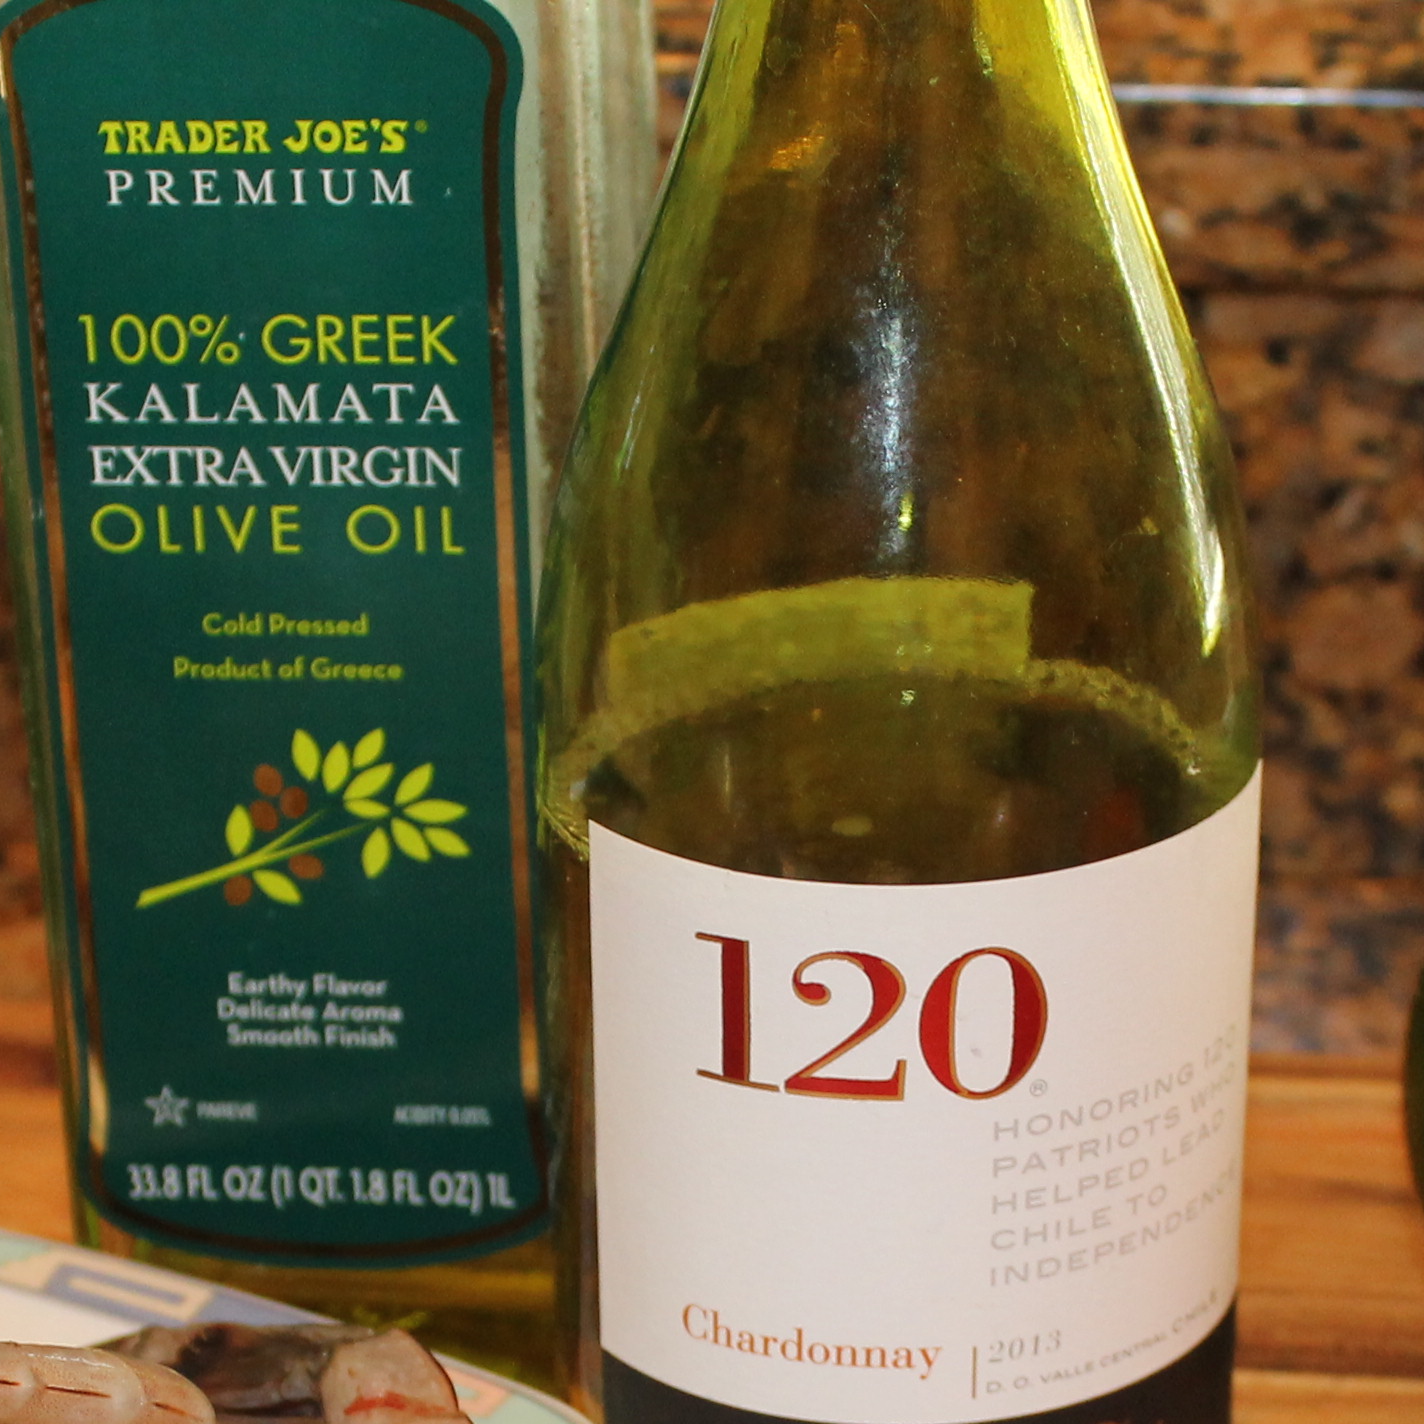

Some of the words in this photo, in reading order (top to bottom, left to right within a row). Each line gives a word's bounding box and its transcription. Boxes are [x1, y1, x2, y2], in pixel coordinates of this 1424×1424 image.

[99, 119, 272, 155] TRADER
[283, 118, 409, 154] JOE'S
[105, 168, 413, 205] PREMIUM
[78, 313, 240, 365] 100%
[262, 313, 459, 365] GREEK
[84, 382, 460, 424] KALAMATA
[88, 445, 266, 487] EXTRA
[268, 446, 462, 488] VIRGIN
[91, 503, 301, 554] OLIVE
[346, 505, 465, 555] OIL
[201, 611, 264, 636] Cold
[268, 611, 370, 637] Pressed
[173, 656, 272, 680] Product
[278, 655, 305, 680] of
[310, 657, 405, 681] Greece
[227, 971, 308, 1001] Earthy
[312, 972, 388, 997] Flavor
[216, 997, 317, 1022] Delicate
[322, 1002, 404, 1023] Aroma
[694, 930, 1048, 1103] 120
[226, 1022, 321, 1047] Smooth
[324, 1023, 398, 1048] Finish
[992, 1062, 1195, 1142] HONORING
[991, 1157, 1150, 1216] HELPED
[1162, 1108, 1225, 1166] LEAD
[992, 1105, 1182, 1179] PATRIOTS
[127, 1163, 181, 1200] 33.8
[186, 1164, 217, 1200] FL
[223, 1165, 266, 1201] OZ
[271, 1165, 294, 1210] (1
[350, 1167, 389, 1206] 1.8
[392, 1169, 426, 1207] FL
[428, 1170, 482, 1216] OZ)
[486, 1172, 517, 1209] 1L
[990, 1205, 1113, 1252] CHILE
[1127, 1183, 1169, 1216] TO
[681, 1302, 944, 1379] Chardonnay
[1039, 1360, 1095, 1385] VALLE
